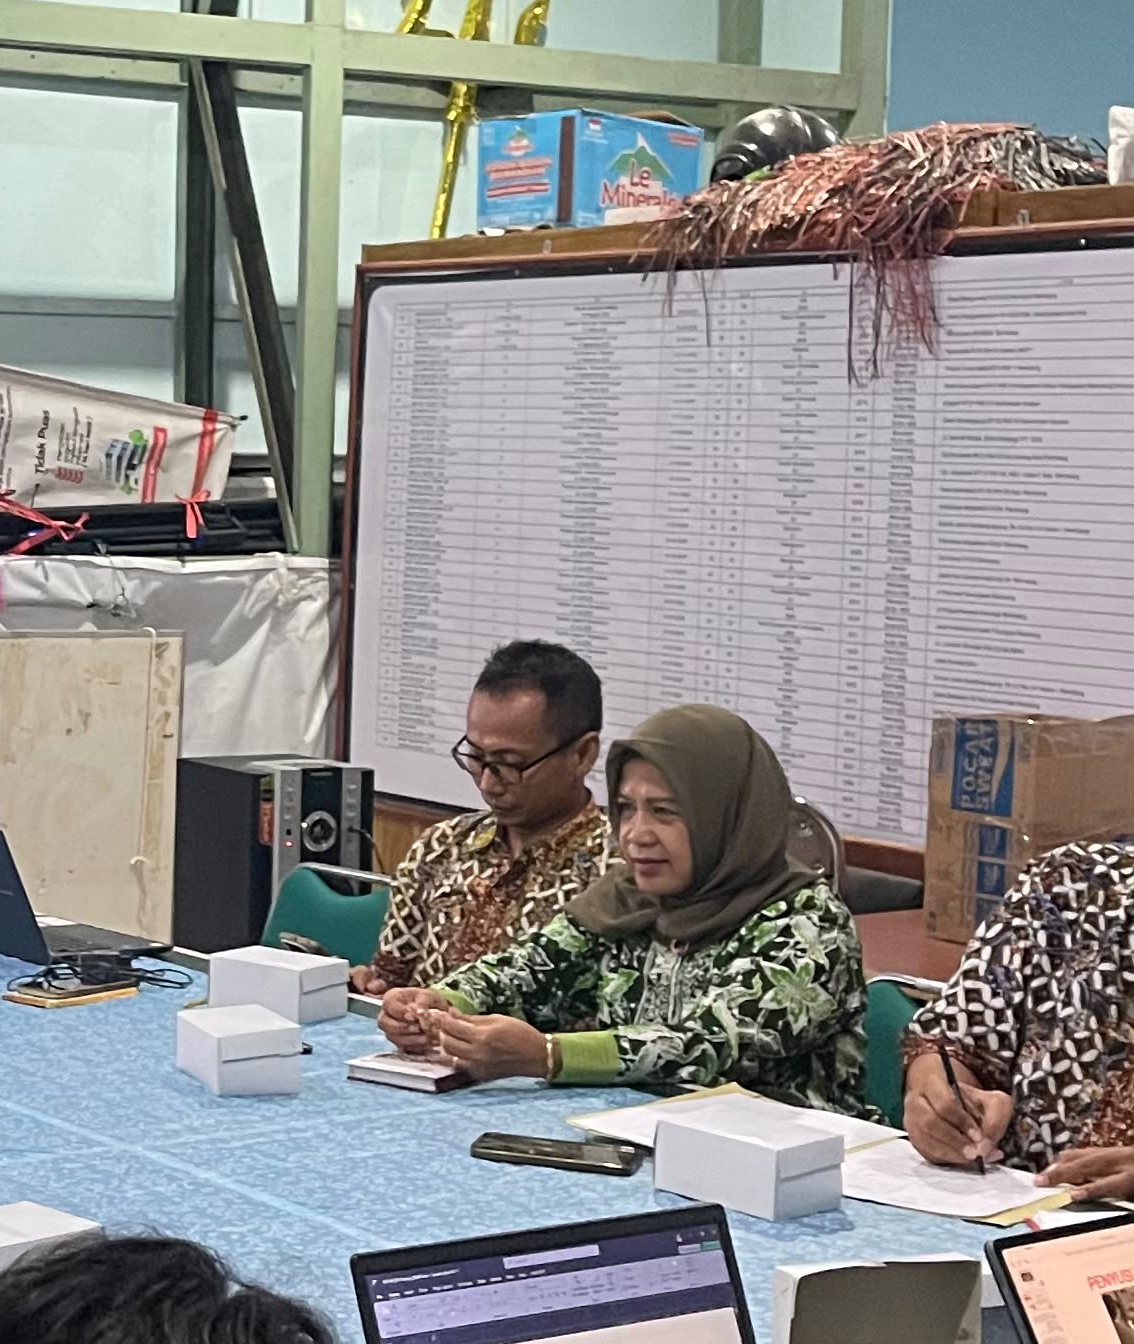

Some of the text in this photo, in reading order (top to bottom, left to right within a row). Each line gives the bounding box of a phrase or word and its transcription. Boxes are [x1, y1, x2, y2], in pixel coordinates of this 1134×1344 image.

[629, 158, 651, 188] Le
[34, 409, 50, 474] Tidak Puas
[1087, 1268, 1134, 1290] PENYUS
